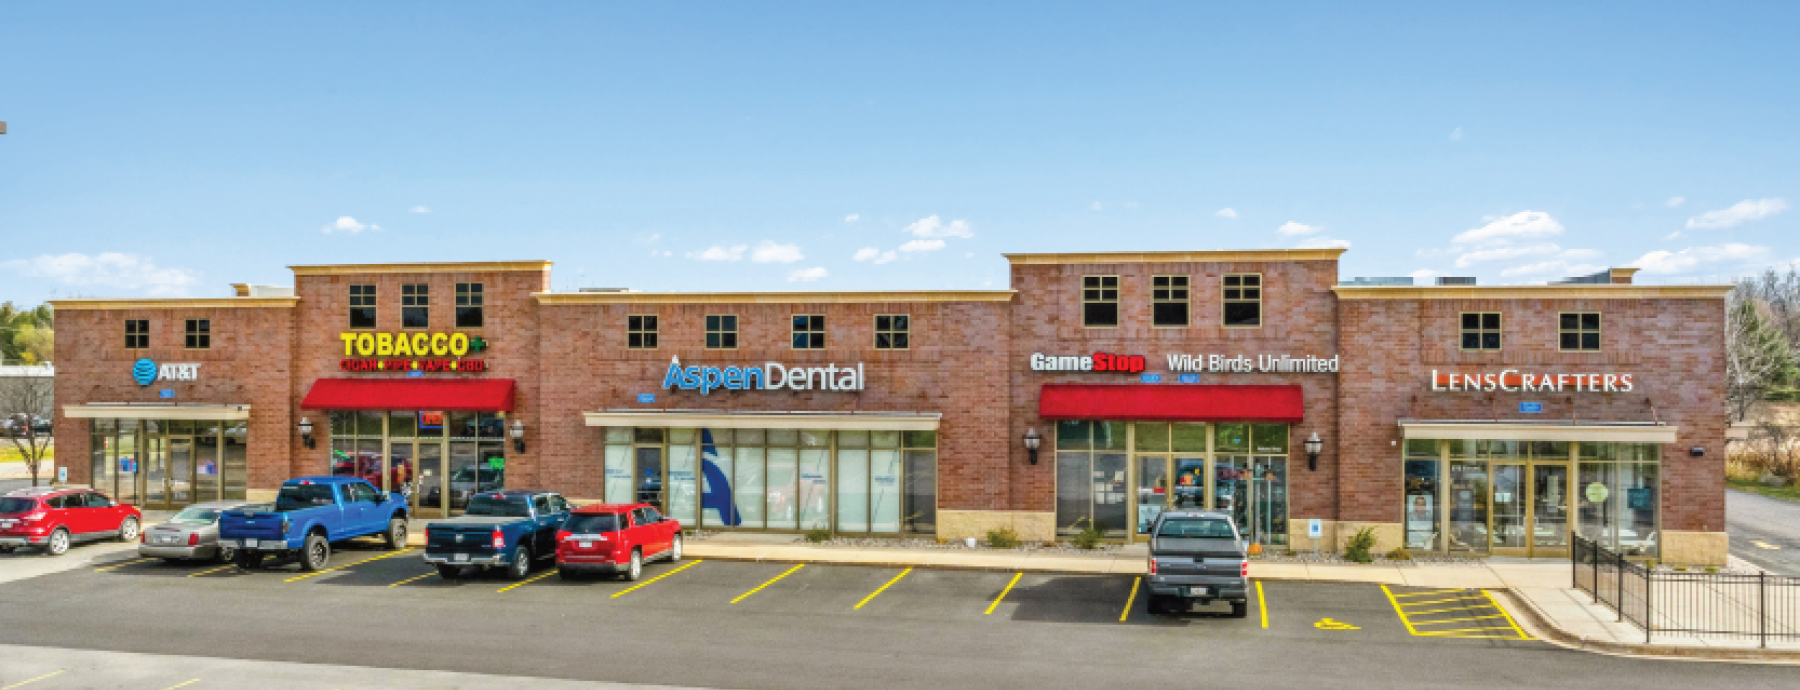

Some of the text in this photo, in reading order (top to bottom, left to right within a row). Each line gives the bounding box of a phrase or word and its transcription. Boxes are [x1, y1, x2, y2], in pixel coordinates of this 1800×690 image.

[157, 362, 202, 382] AT&T
[1030, 352, 1146, 373] GameStop
[1166, 354, 1340, 373] Wild Birds Unlimited
